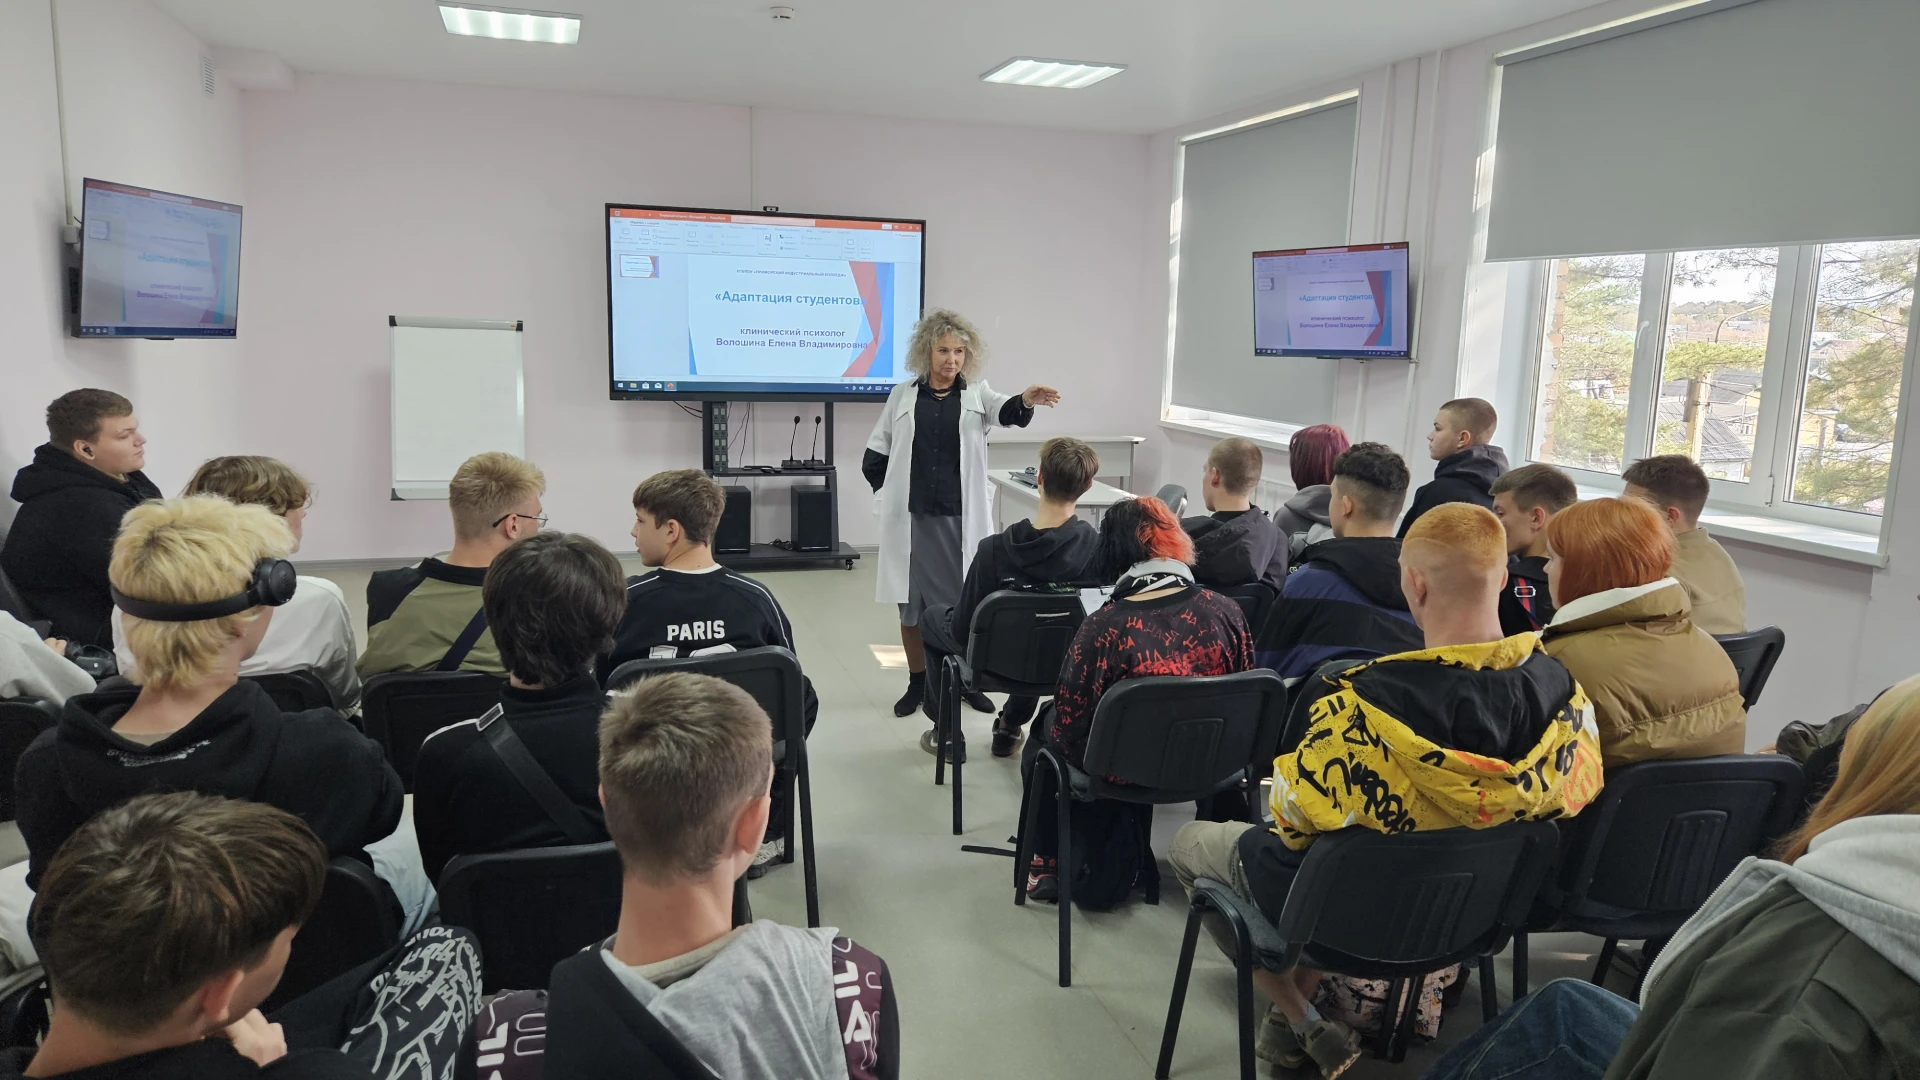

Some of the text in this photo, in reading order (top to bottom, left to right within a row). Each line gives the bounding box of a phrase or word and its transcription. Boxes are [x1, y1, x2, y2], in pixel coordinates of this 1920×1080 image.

[714, 290, 792, 304] «Адаптация
[740, 327, 846, 338] клинический психолог
[716, 337, 868, 351] Волошина Елена Владимировна
[666, 619, 726, 642] PARIS
